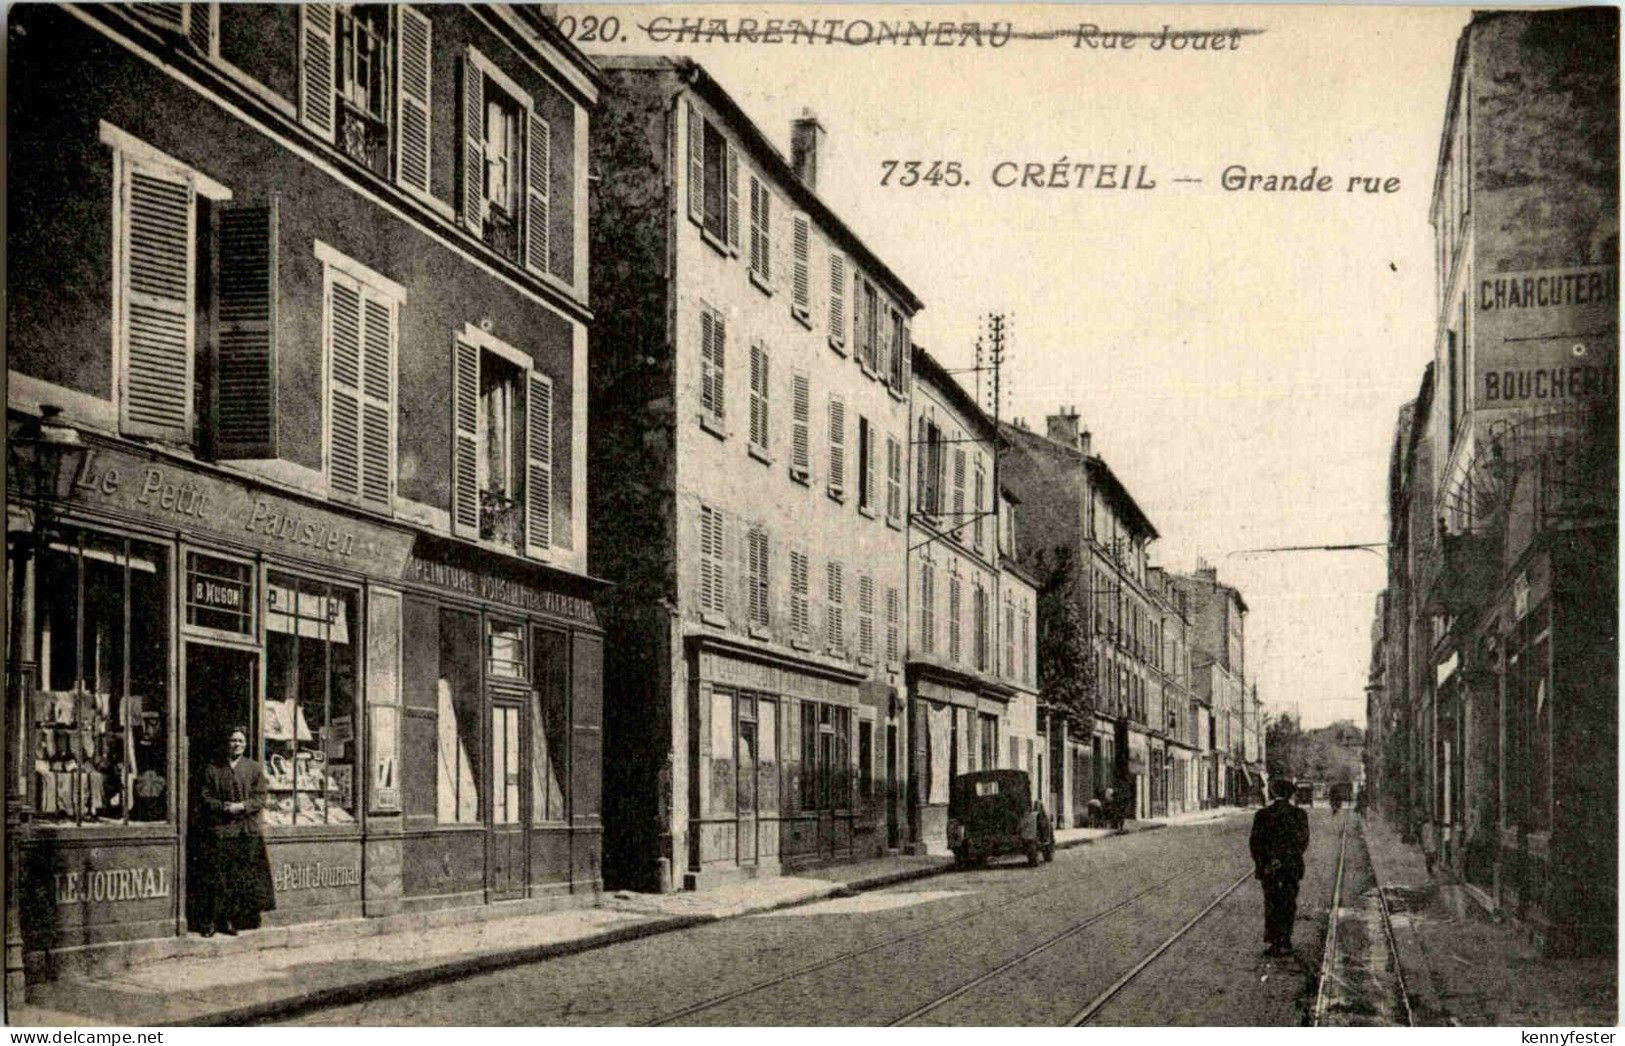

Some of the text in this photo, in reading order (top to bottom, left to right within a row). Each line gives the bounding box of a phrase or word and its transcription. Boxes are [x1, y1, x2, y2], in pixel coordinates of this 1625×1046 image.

[76, 449, 354, 557] Le Petit Parisien
[415, 558, 475, 593] PEINTURE
[54, 866, 170, 904] LE JOURNAL
[283, 863, 311, 891] Petit
[312, 860, 361, 888] Journal
